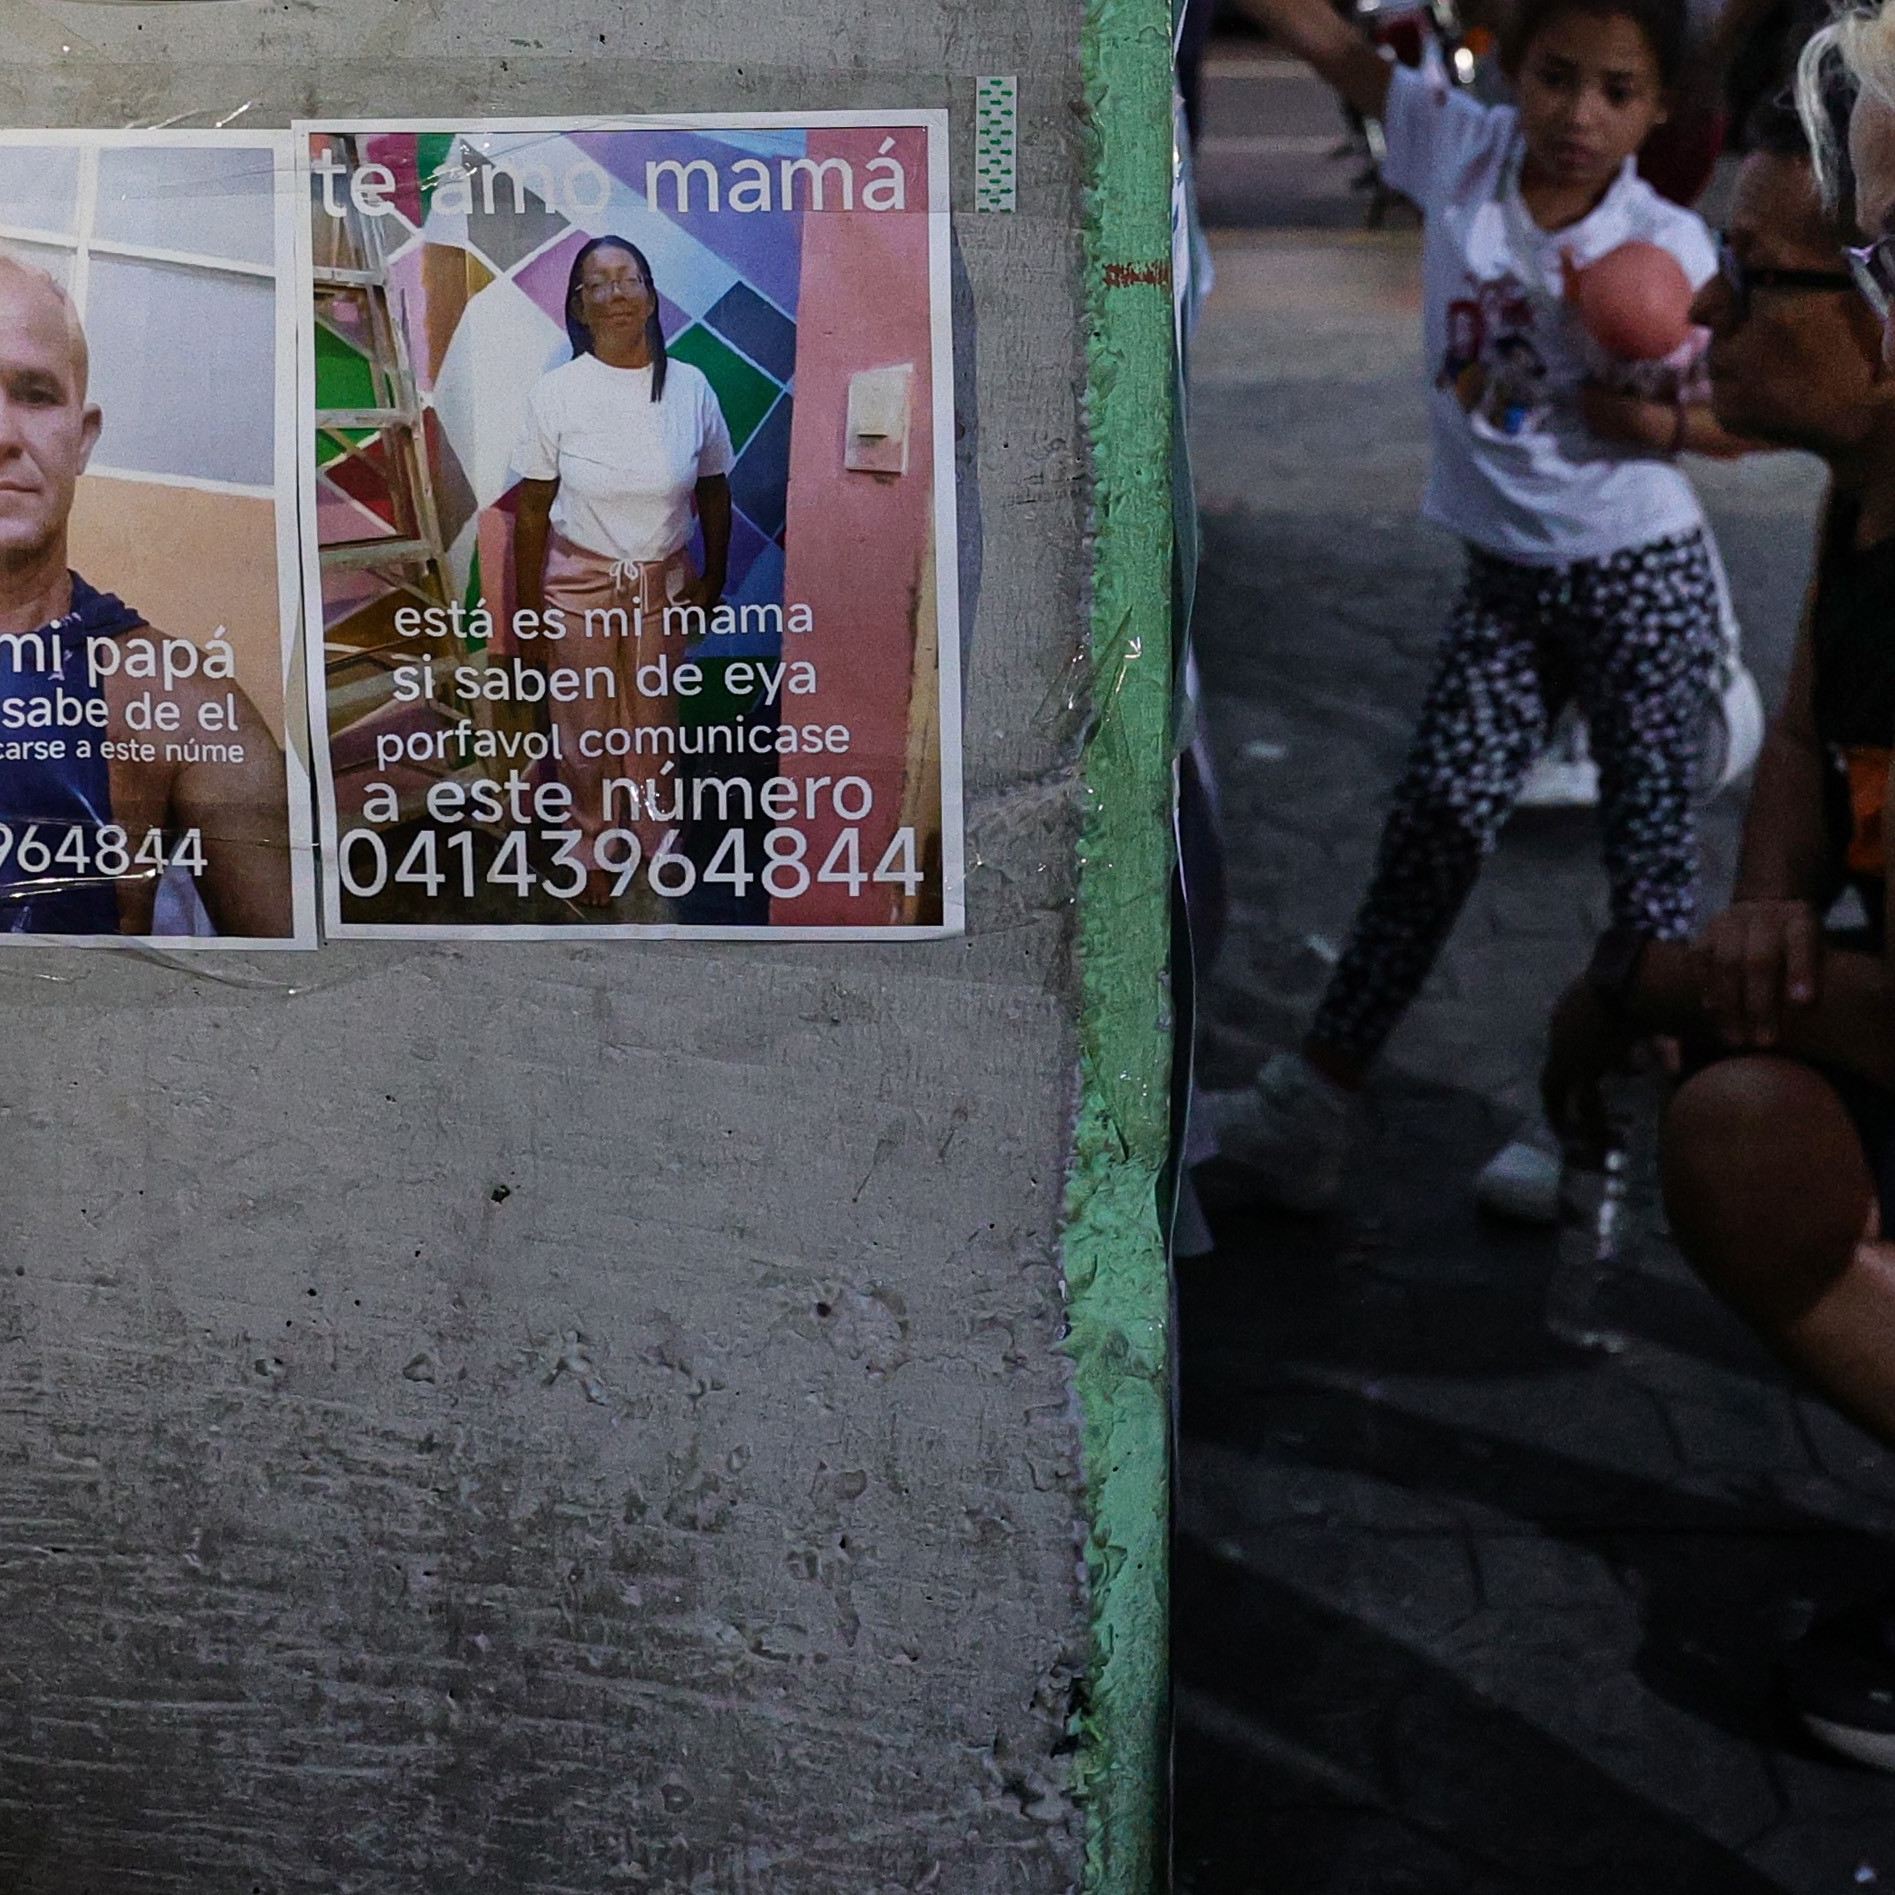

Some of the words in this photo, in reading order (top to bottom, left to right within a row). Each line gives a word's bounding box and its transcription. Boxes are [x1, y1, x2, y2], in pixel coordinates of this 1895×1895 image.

[311, 147, 396, 220] te
[646, 136, 907, 215] mamá
[394, 596, 494, 639] está
[512, 605, 567, 639] es
[584, 596, 643, 637] mi
[662, 600, 813, 636] mama
[85, 625, 235, 690] papá
[392, 653, 435, 703] si
[454, 657, 615, 702] saben
[635, 653, 703, 697] de
[724, 660, 816, 705] eya
[1, 685, 109, 728] sabe
[124, 688, 181, 732] de
[197, 692, 238, 731] el
[75, 739, 91, 758] a
[99, 738, 155, 762] este
[165, 737, 244, 763] núme
[376, 719, 563, 770] porfavol
[578, 714, 849, 759] comunicase
[361, 781, 398, 824] a
[425, 769, 573, 824] este
[601, 760, 874, 823] número
[338, 826, 924, 899] 04143964844
